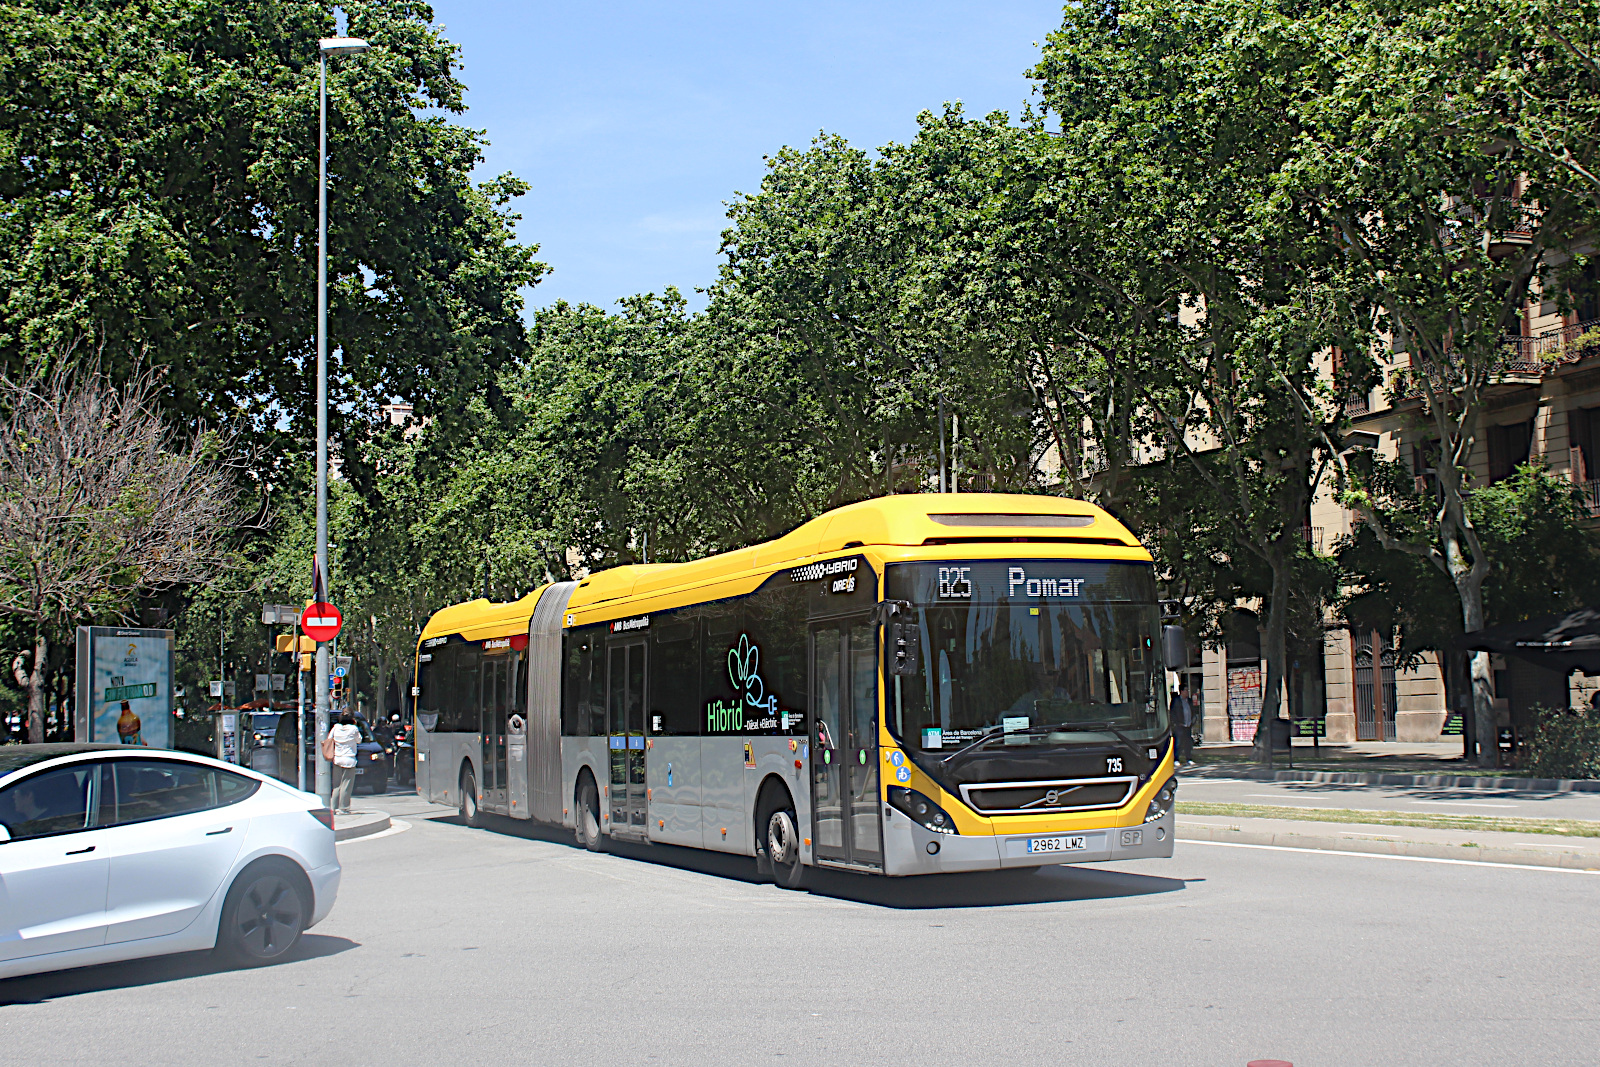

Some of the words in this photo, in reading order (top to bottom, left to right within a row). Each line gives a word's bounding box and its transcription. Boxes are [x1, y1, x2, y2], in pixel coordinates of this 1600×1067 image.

[822, 559, 858, 575] HYBRID
[938, 567, 972, 598] B25
[1008, 567, 1085, 597] Pomar
[707, 699, 743, 732] Híbrid
[1106, 758, 1122, 773] 735
[1033, 839, 1060, 852] 2962
[1065, 837, 1084, 849] LMZ
[1123, 831, 1140, 844] SP
